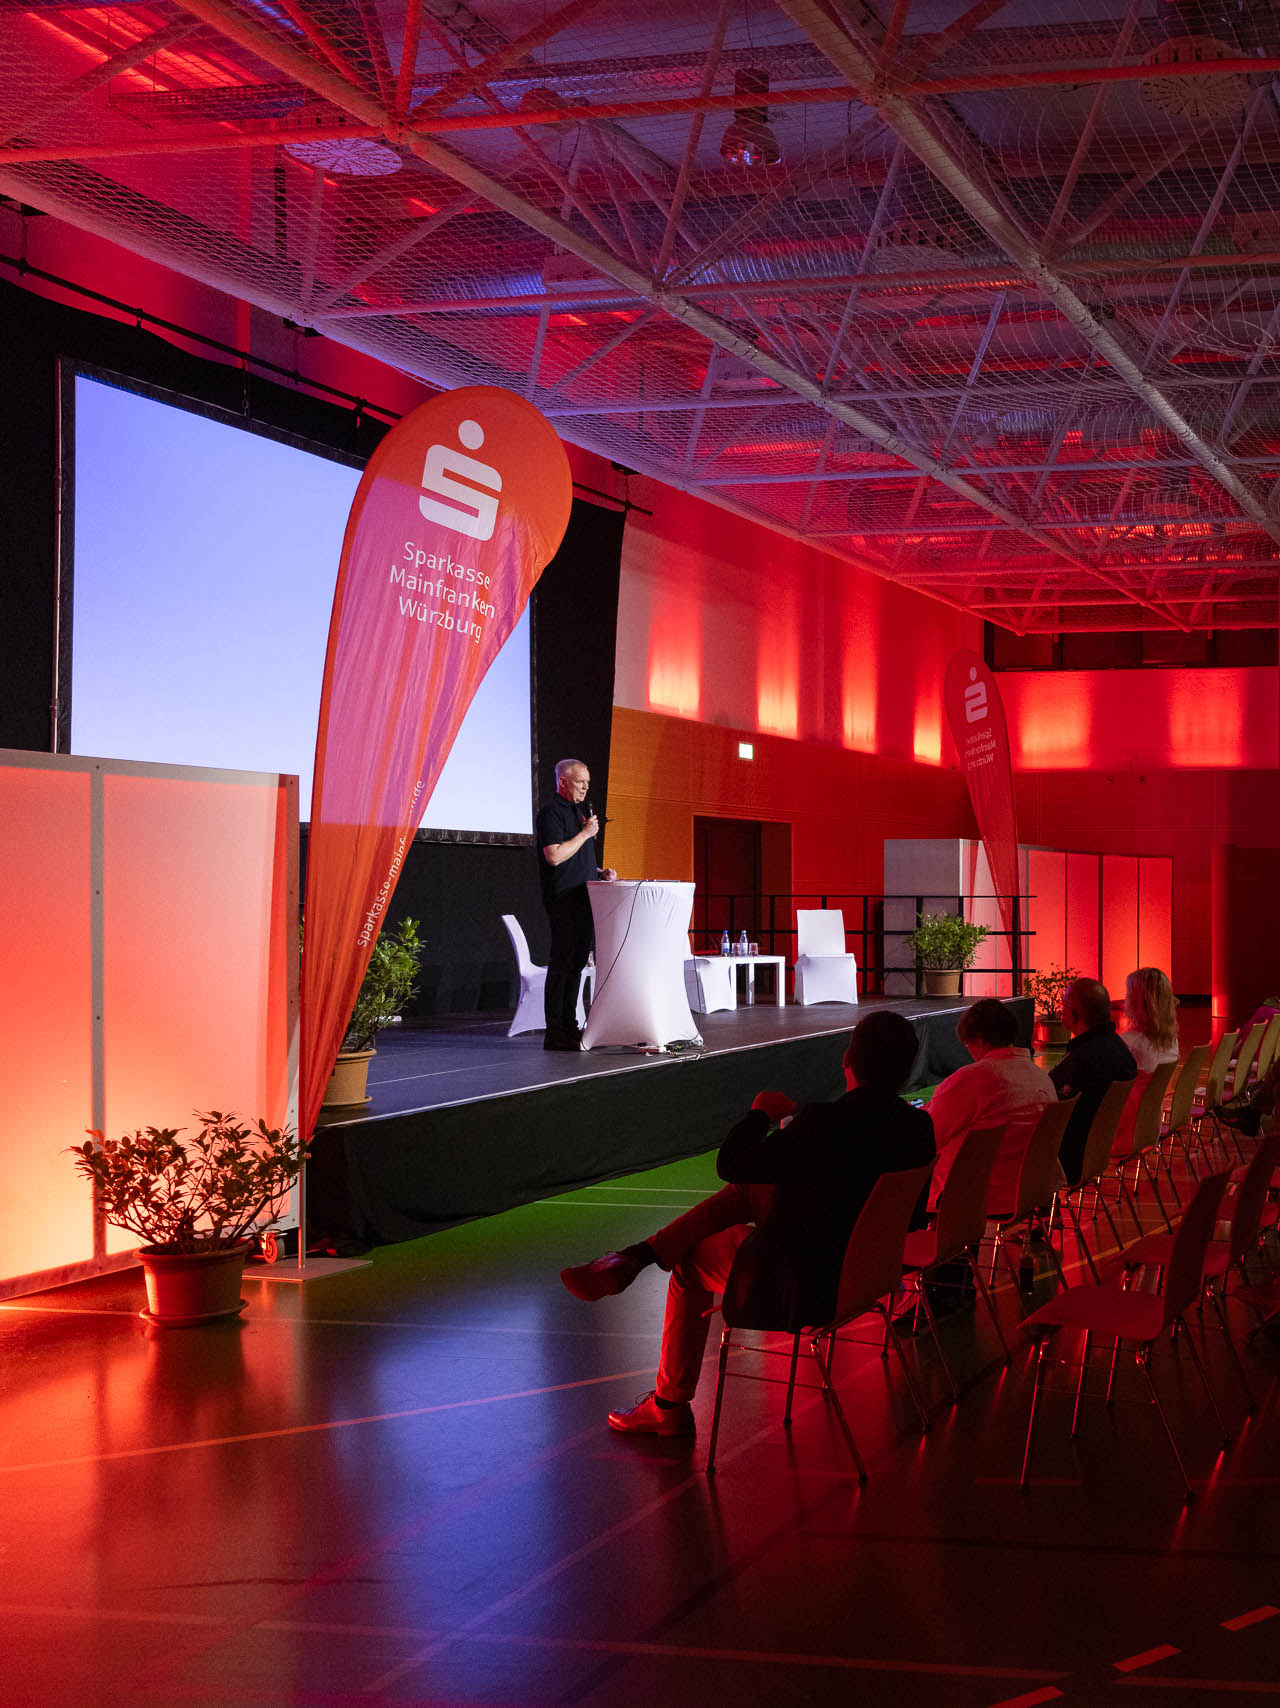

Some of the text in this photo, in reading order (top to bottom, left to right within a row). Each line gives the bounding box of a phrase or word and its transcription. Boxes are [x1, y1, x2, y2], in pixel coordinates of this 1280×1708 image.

[403, 541, 490, 590] Sparkasse
[389, 565, 495, 619] Mainfranken
[399, 595, 482, 644] Würzburg
